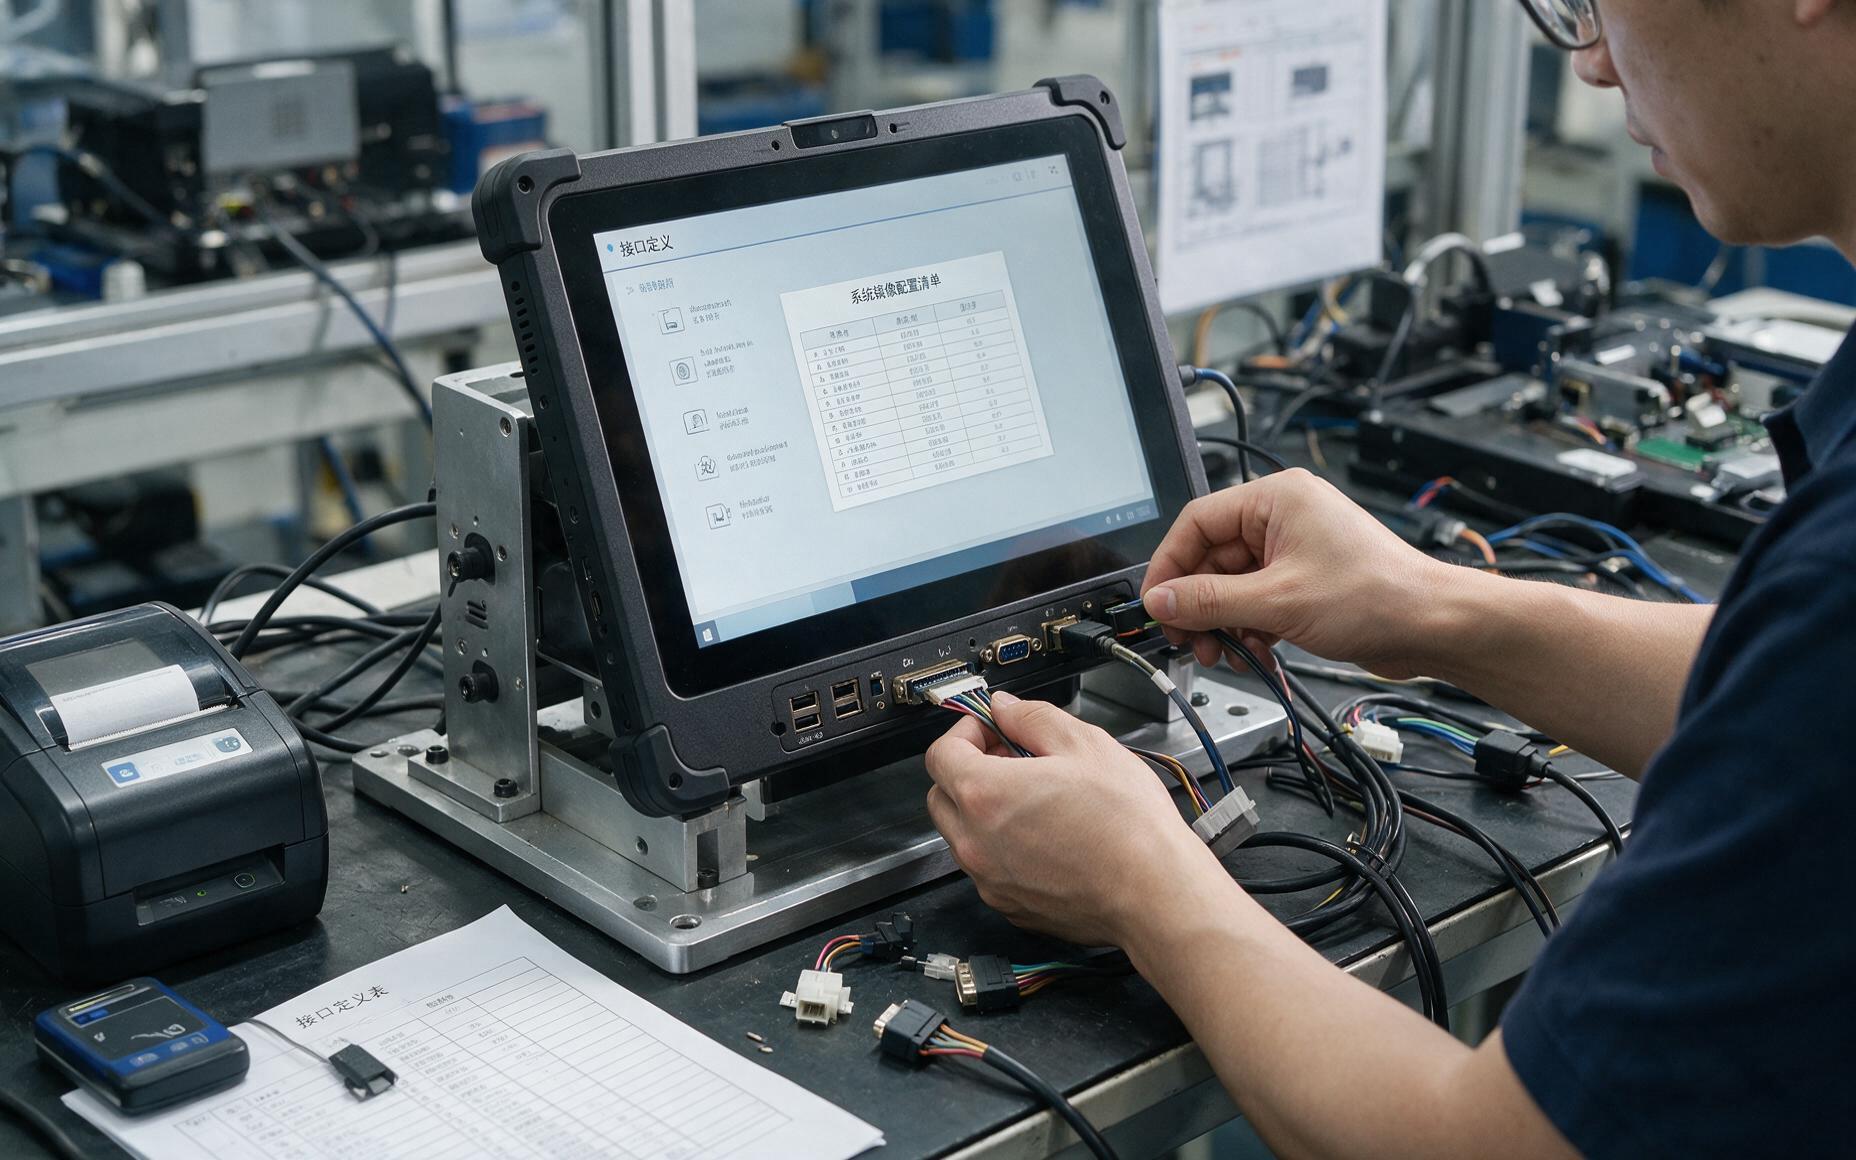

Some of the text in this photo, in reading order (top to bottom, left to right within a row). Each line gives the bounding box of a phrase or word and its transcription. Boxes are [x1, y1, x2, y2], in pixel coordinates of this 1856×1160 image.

[620, 234, 674, 257] 接口定义
[295, 984, 389, 1029] 接口定义表
